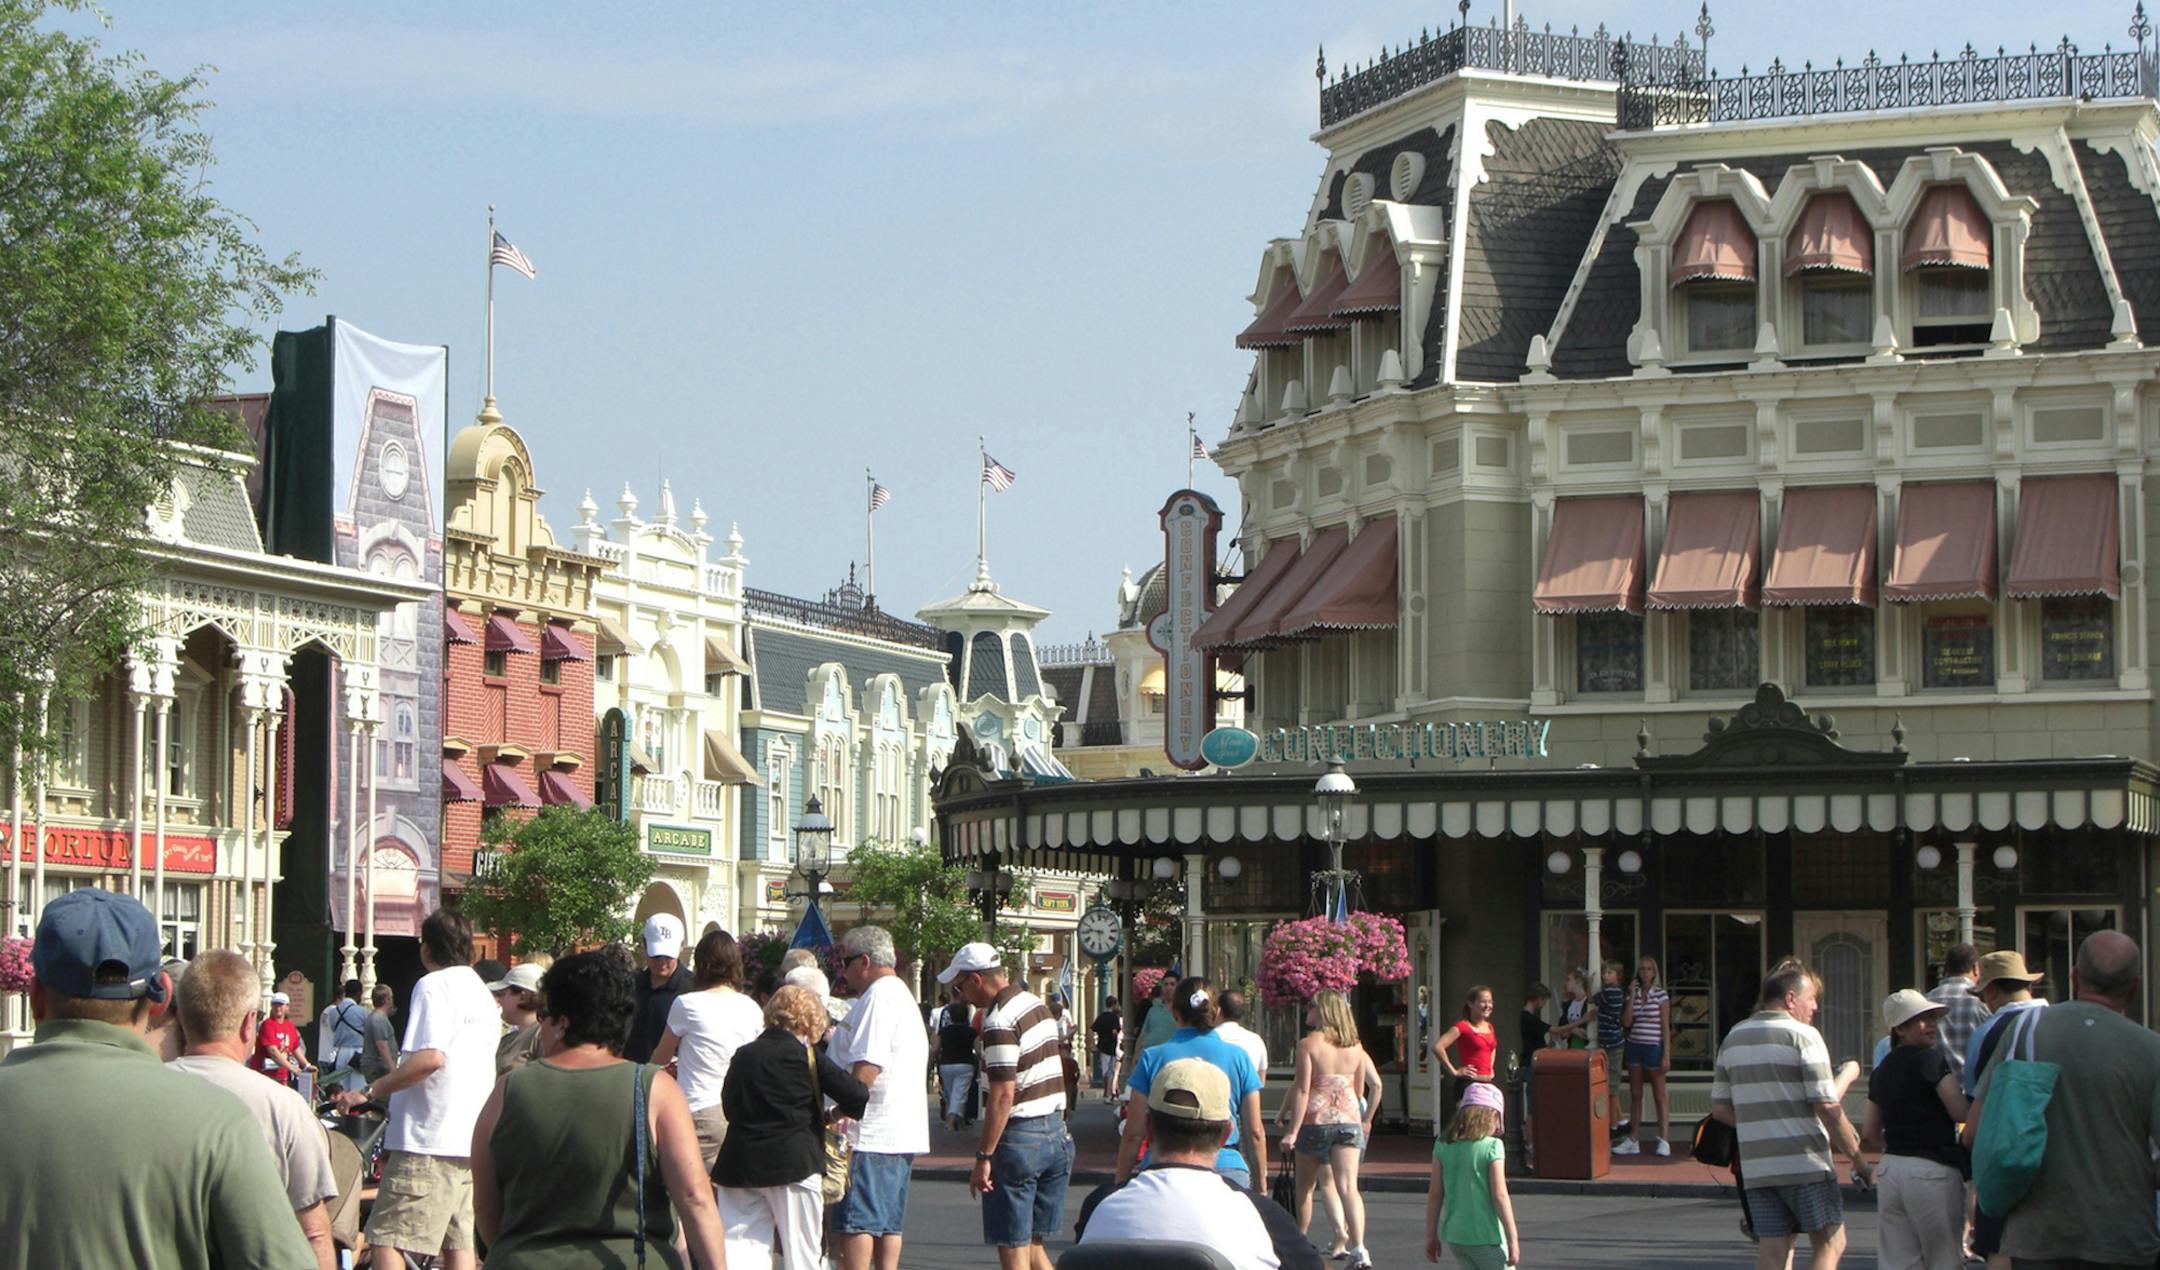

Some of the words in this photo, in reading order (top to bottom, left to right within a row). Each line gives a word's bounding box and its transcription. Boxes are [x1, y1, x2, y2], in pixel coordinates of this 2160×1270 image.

[1180, 521, 1193, 752] CONFECTIONERY
[1261, 719, 1551, 763] CONFECTIONERY
[653, 831, 705, 849] ARCADE
